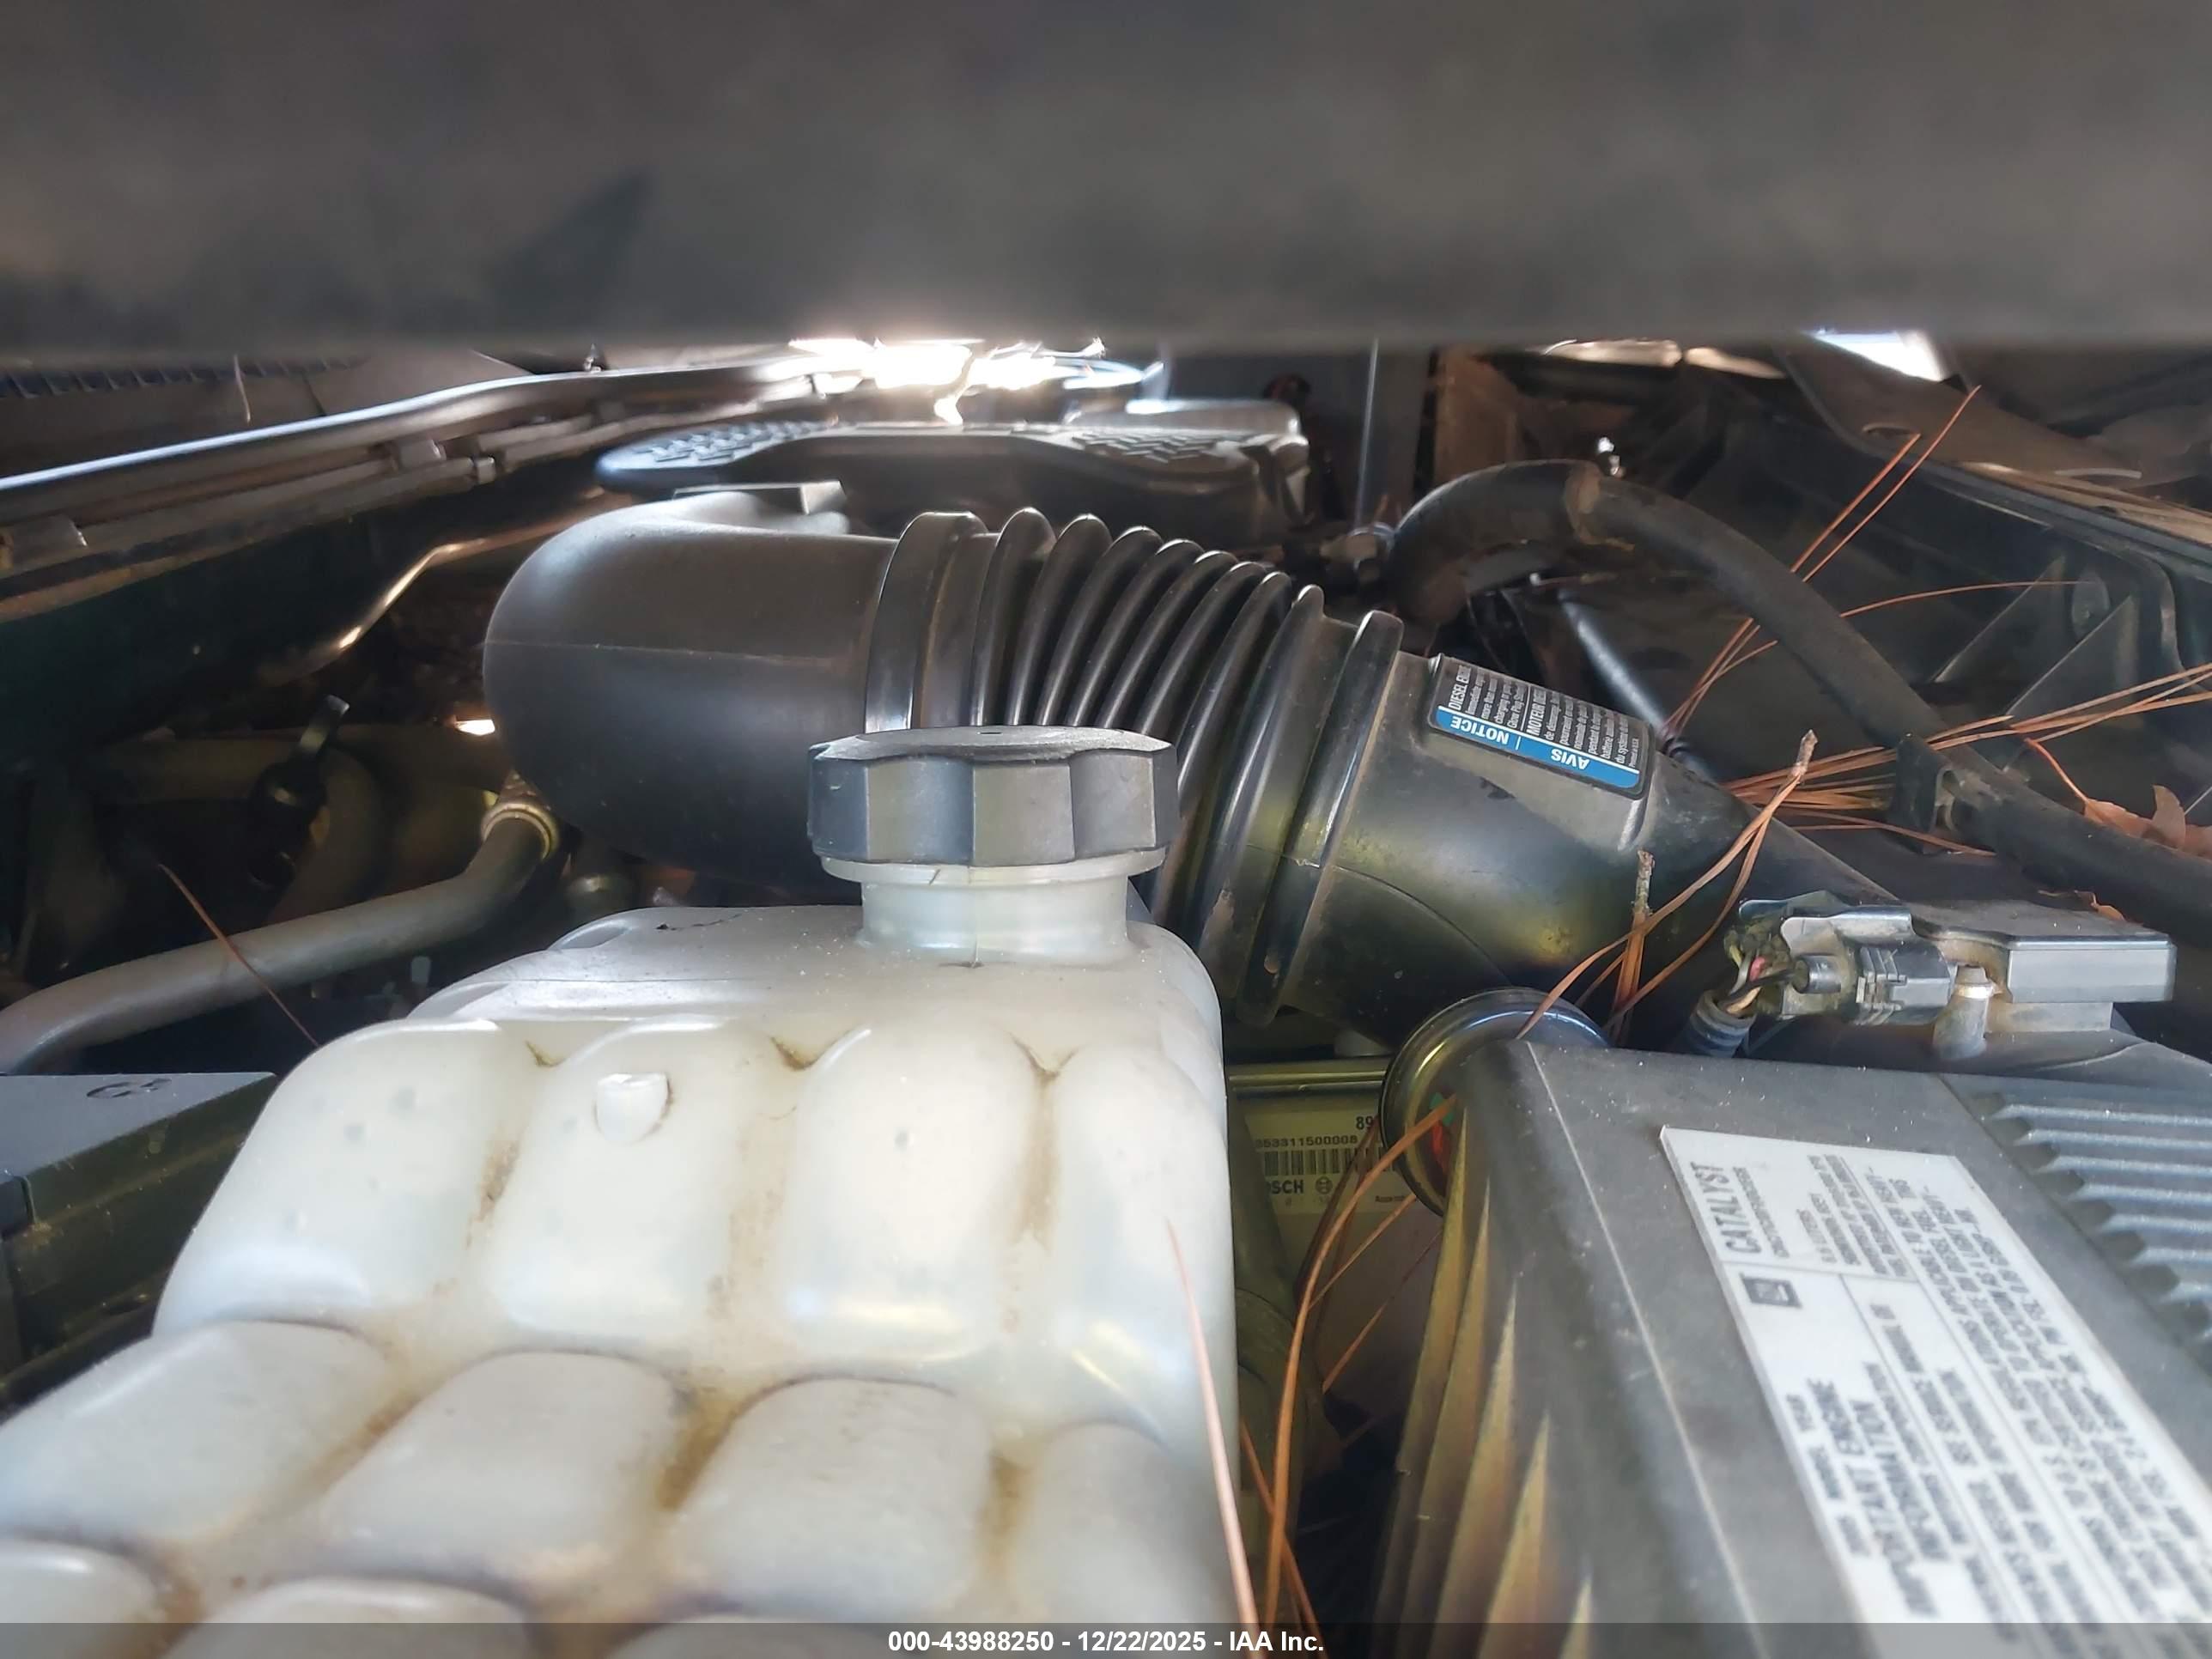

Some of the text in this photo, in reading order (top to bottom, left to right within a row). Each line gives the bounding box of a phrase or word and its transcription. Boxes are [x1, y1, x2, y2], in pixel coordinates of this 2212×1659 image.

[1448, 684, 1468, 711] DIESEL
[1450, 715, 1509, 744] NOTICE
[1527, 703, 1546, 736] MOTEUR
[1551, 748, 1589, 770] AVIS
[1267, 1179, 1304, 1194] SCH
[1691, 1162, 1763, 1255] CATALYST
